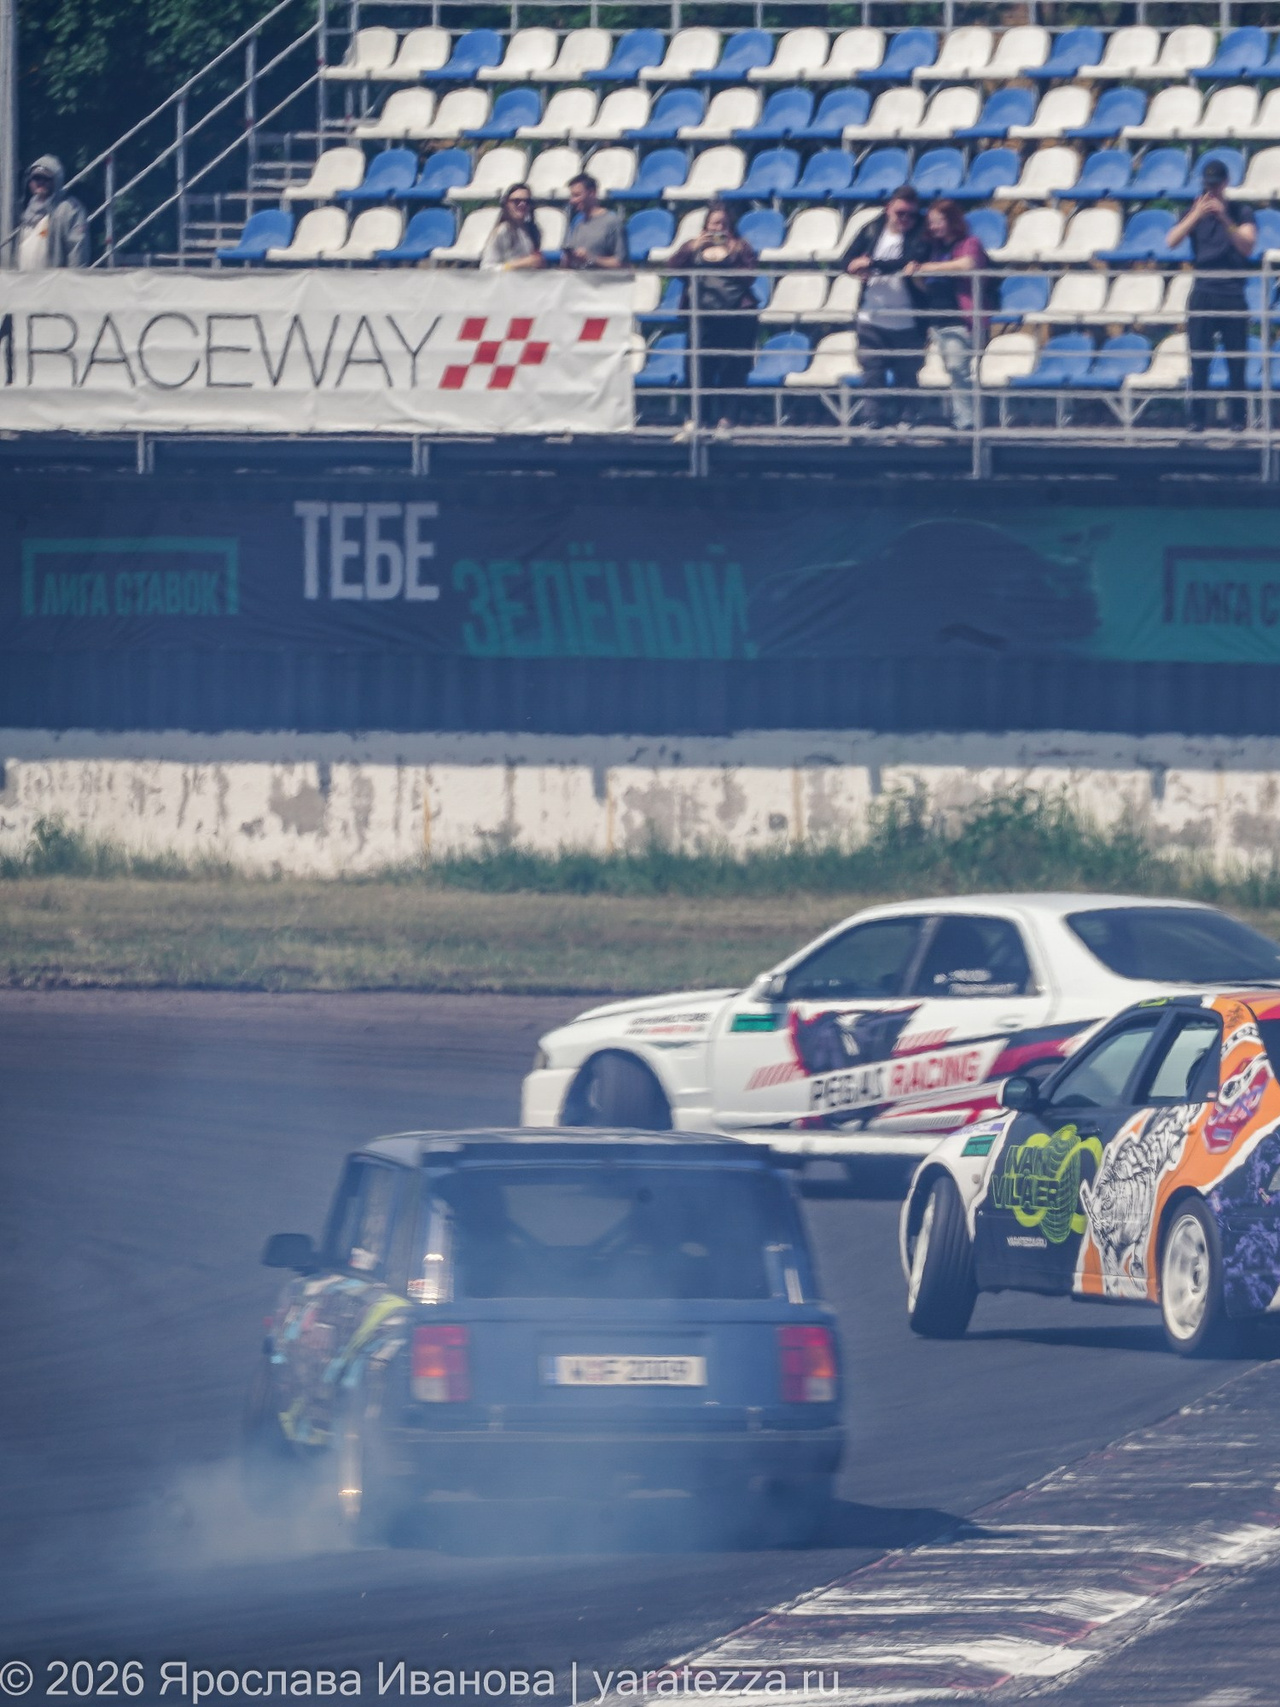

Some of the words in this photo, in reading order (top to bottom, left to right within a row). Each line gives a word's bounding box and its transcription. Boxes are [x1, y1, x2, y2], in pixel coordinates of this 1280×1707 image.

[0, 312, 442, 389] RACEWAY
[294, 500, 440, 601] ТЕБЕ
[888, 1050, 982, 1097] RACING
